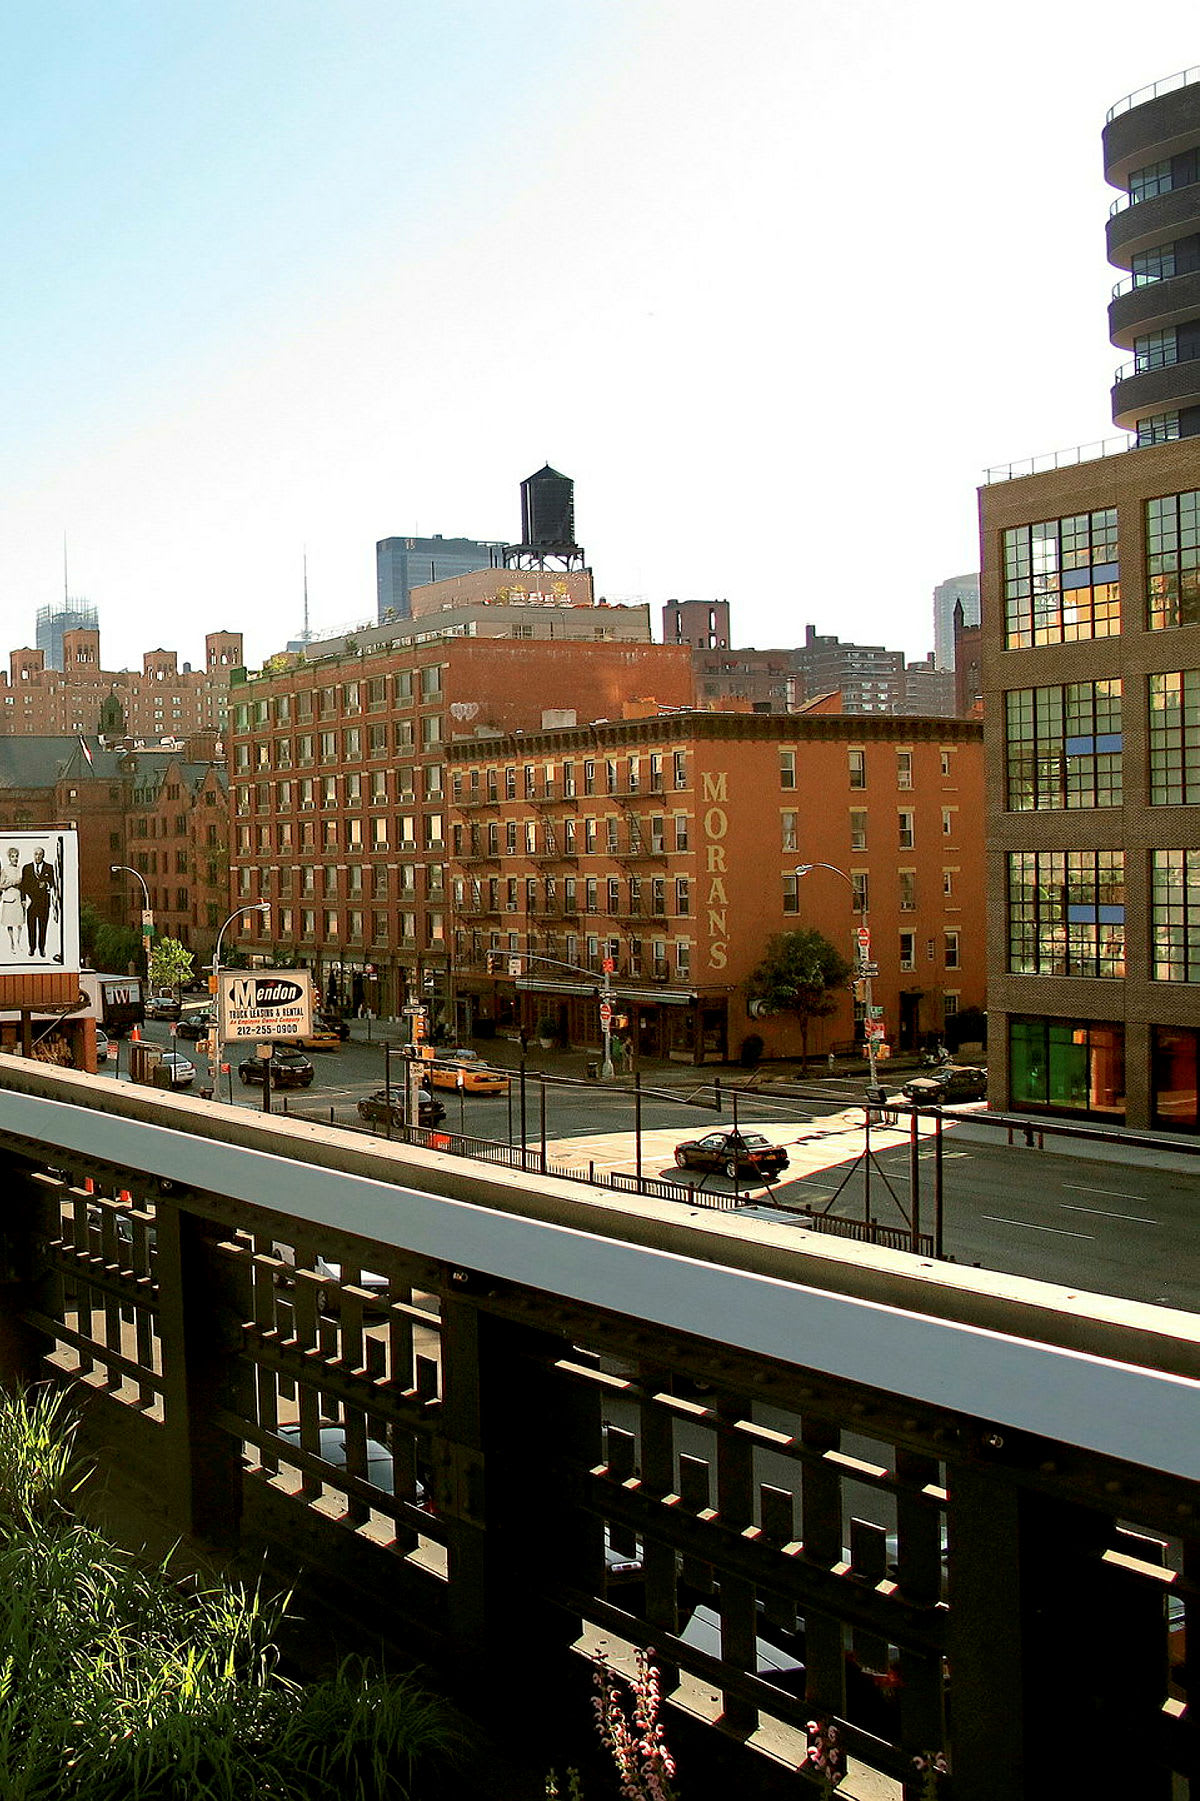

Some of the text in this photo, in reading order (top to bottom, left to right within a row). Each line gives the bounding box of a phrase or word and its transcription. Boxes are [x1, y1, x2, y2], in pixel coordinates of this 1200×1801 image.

[233, 978, 297, 1009] Mendon
[229, 1010, 249, 1019] TRUCK
[250, 1008, 274, 1018] LEASING
[282, 1007, 304, 1017] RENTAL
